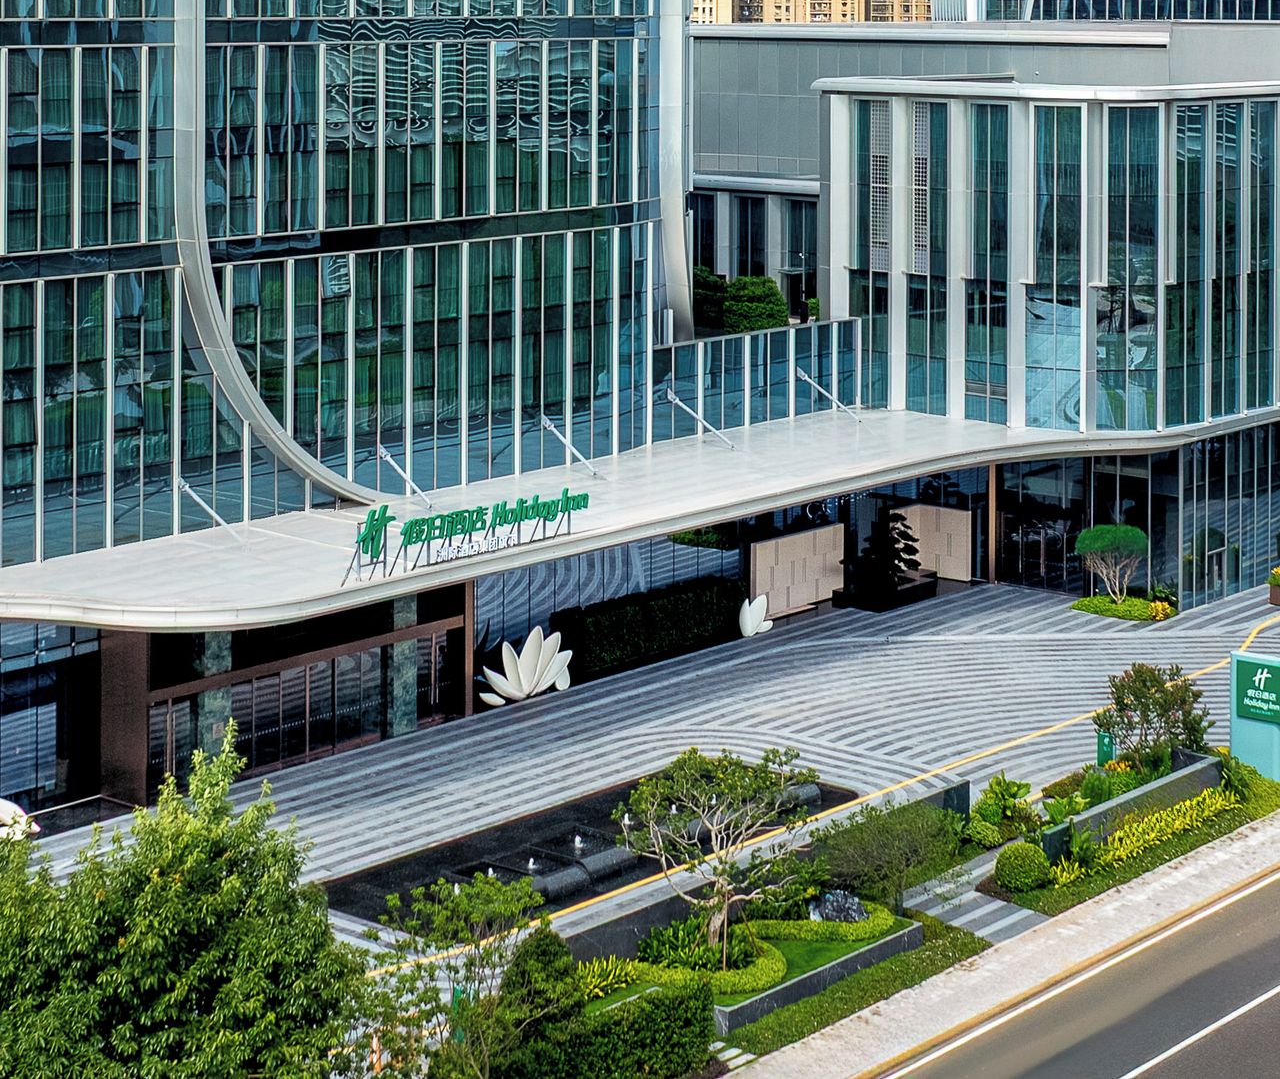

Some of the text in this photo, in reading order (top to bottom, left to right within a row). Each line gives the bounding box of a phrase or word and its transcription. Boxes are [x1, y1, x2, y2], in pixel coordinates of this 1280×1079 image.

[400, 505, 489, 547] 假日酒店
[489, 494, 560, 528] Holiday
[560, 487, 590, 513] Inn
[1243, 697, 1280, 711] Holiday Inn
